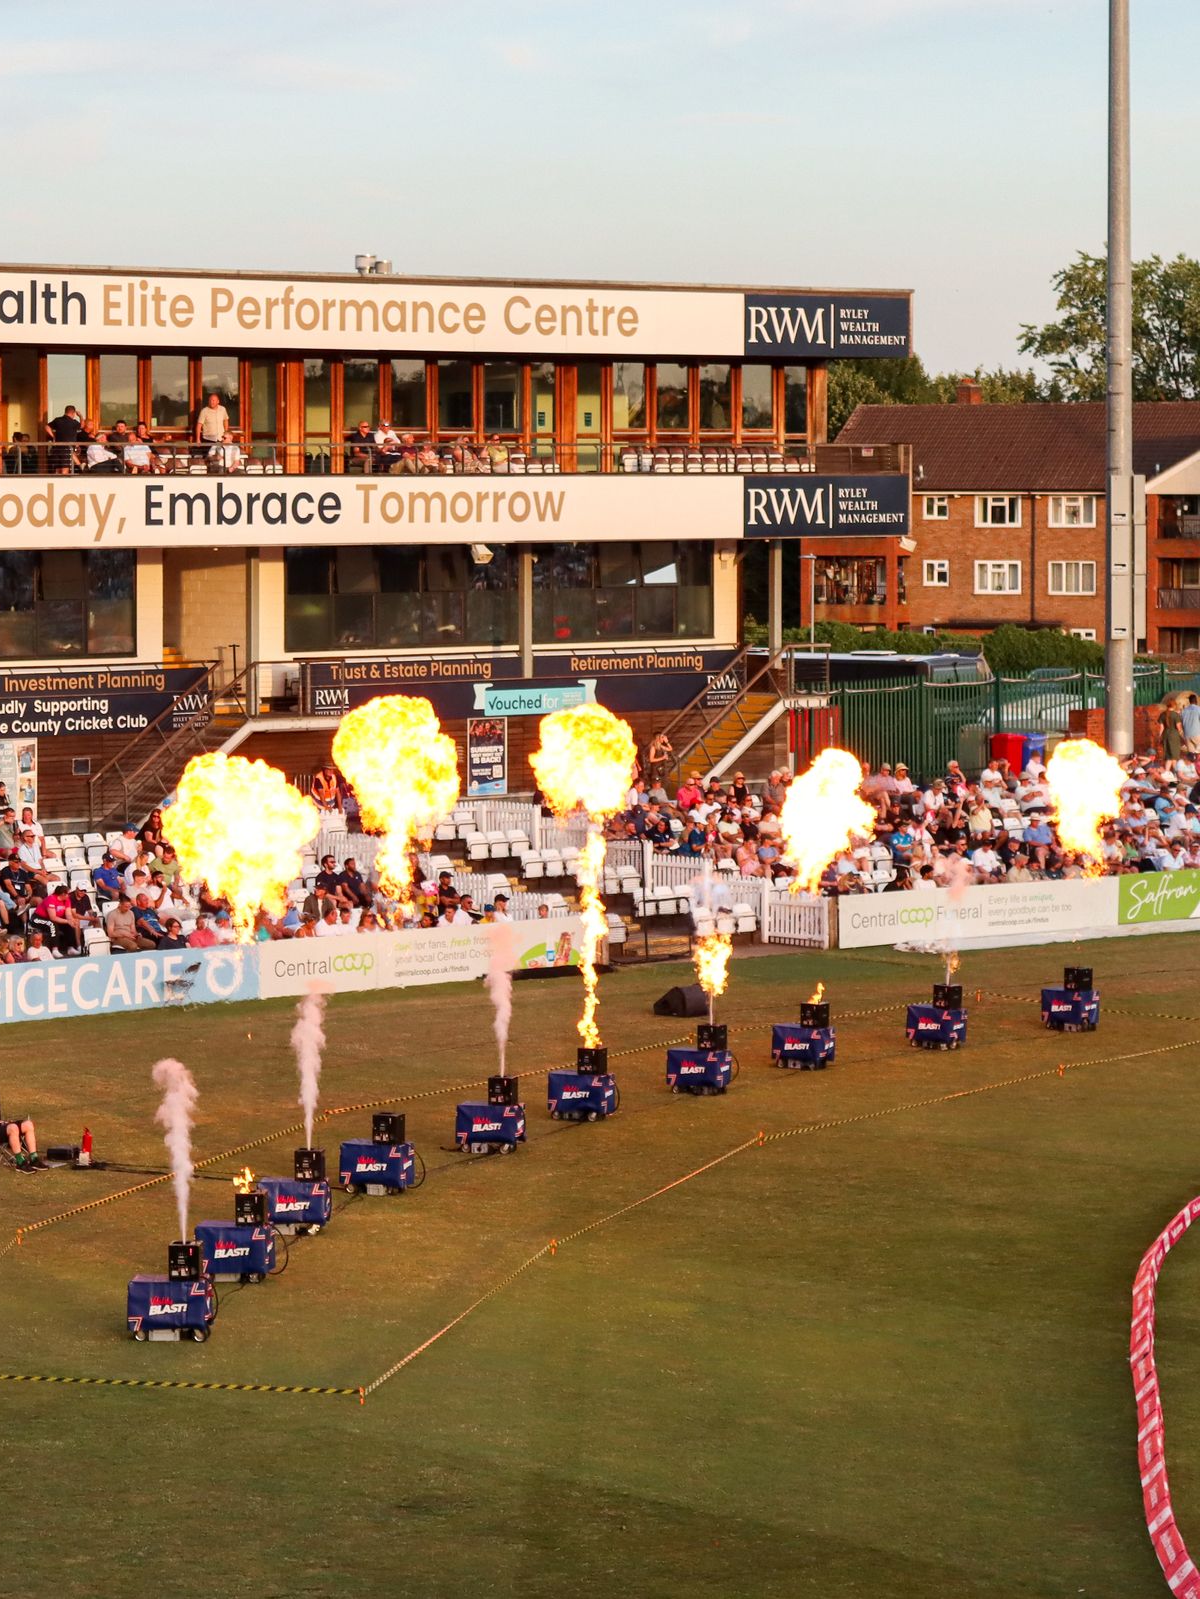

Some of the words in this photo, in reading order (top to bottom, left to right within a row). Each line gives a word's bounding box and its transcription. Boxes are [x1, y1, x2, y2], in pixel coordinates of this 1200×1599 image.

[103, 280, 195, 328] Elite
[211, 286, 486, 334] Performance
[504, 296, 639, 337] Centre
[840, 309, 869, 320] RYLEY
[748, 306, 826, 344] RWM
[840, 322, 880, 332] WEALTH
[840, 335, 906, 346] MANAGEMENT
[838, 488, 868, 498] RYLEY
[144, 482, 342, 526] Embrace
[356, 484, 566, 524] Tomorrow
[748, 488, 825, 525] RWM
[838, 501, 878, 511] WEALTH
[838, 513, 904, 524] MANAGEMENT
[571, 656, 644, 671] Retirement
[647, 654, 703, 671] Planning
[331, 664, 367, 680] Trust
[370, 664, 380, 679] &
[384, 663, 427, 678] Estate
[431, 661, 491, 679] Planning
[4, 674, 94, 692] Investment
[98, 671, 165, 691] Planning
[315, 689, 349, 705] RWM
[34, 697, 109, 715] Supporting
[11, 718, 61, 736] County
[65, 716, 114, 731] Cricket
[117, 714, 148, 729] Club
[1127, 874, 1198, 919] Saffron
[851, 911, 899, 929] Central
[936, 904, 983, 921] Fneral
[437, 951, 468, 961] Central
[274, 955, 332, 979] Central
[681, 1066, 705, 1074] BLAST!
[562, 1091, 589, 1099] BLAST!
[472, 1122, 501, 1132] BLAST!
[356, 1163, 387, 1172] BLAST!
[276, 1202, 310, 1213] BLAST!
[214, 1247, 250, 1259] BLAST!
[149, 1303, 188, 1316] BLAST!
